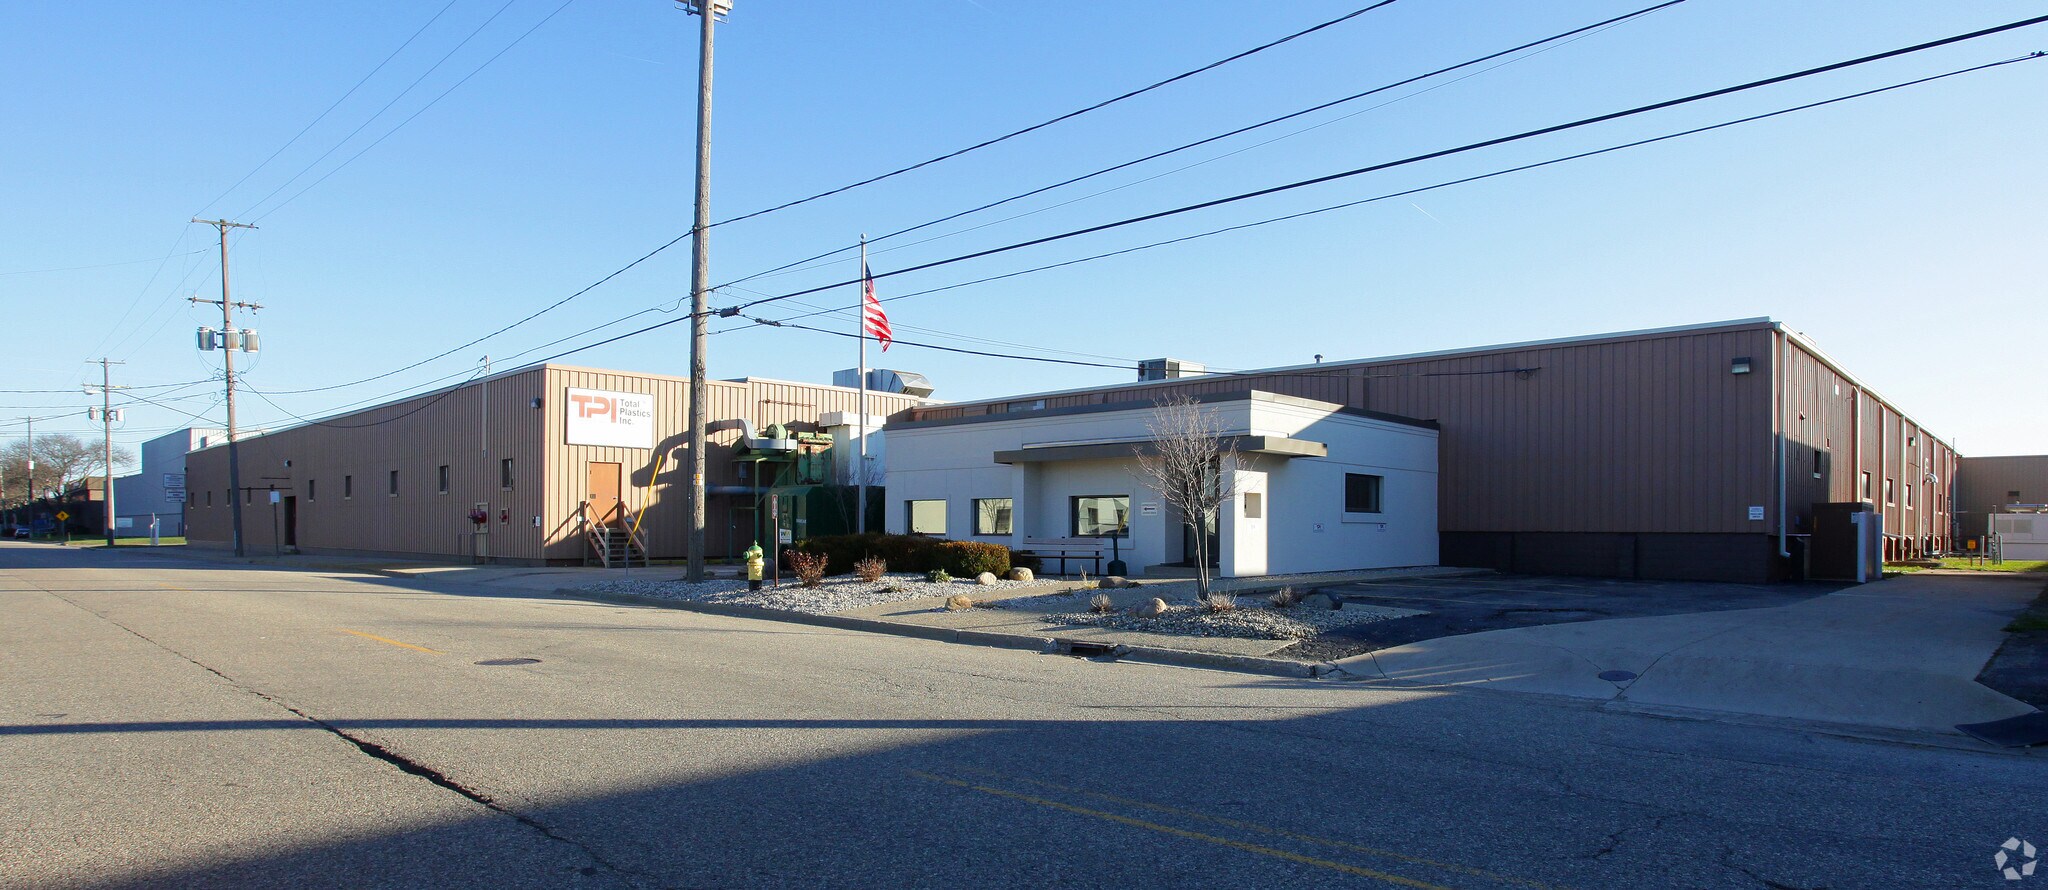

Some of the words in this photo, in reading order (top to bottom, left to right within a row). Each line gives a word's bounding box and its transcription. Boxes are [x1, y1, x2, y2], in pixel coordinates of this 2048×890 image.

[571, 394, 617, 423] TPI
[620, 399, 640, 408] Total
[619, 408, 651, 418] Plastics
